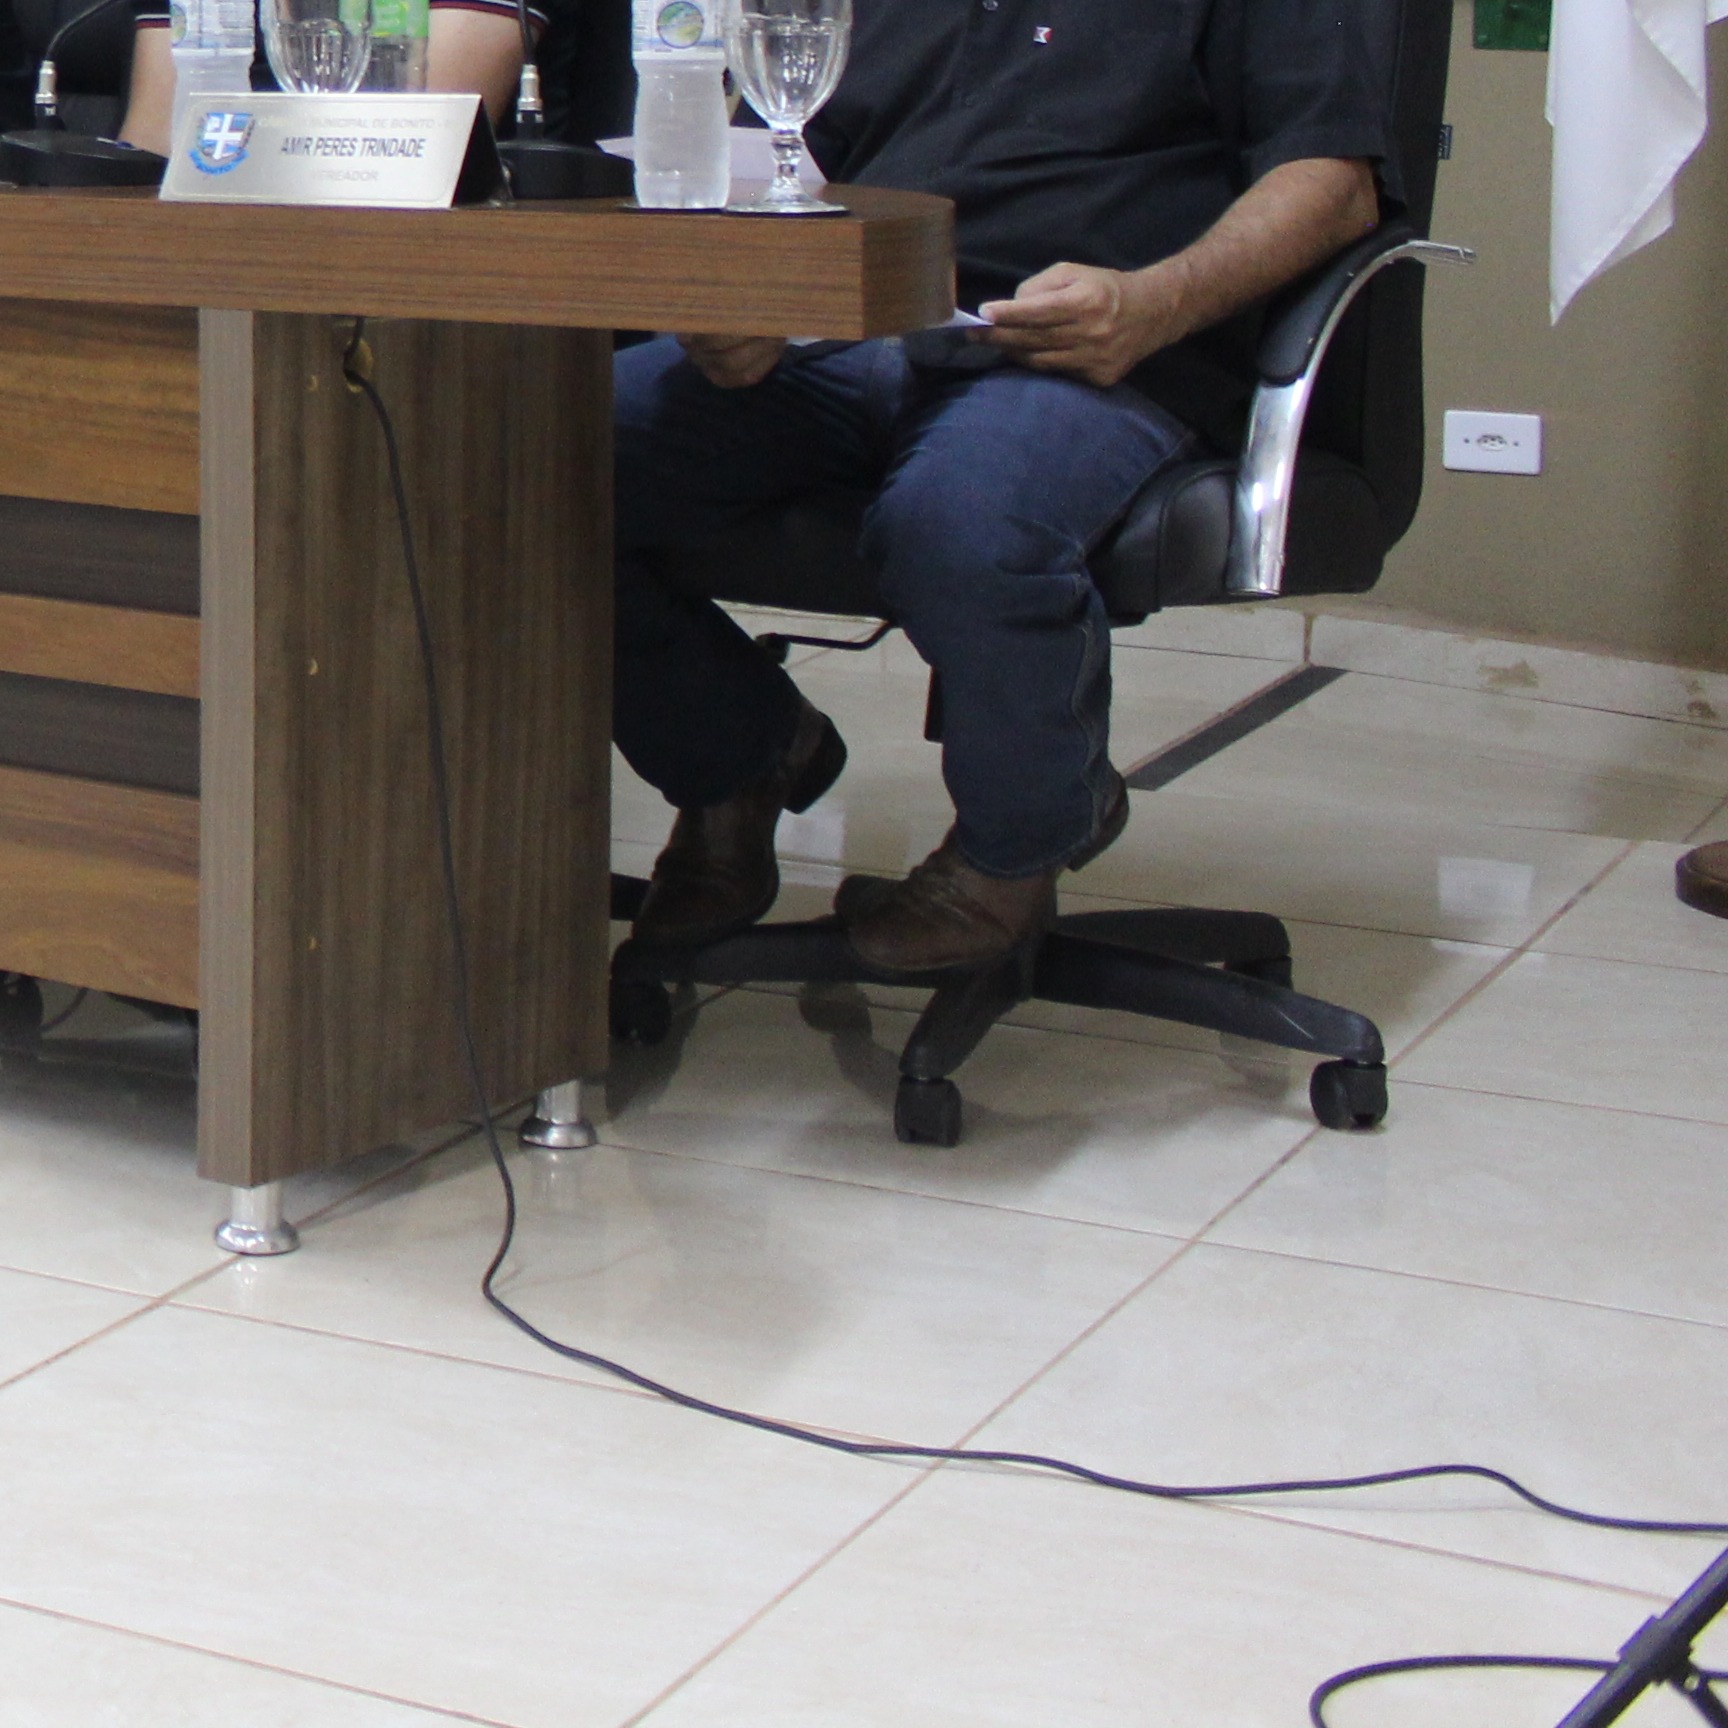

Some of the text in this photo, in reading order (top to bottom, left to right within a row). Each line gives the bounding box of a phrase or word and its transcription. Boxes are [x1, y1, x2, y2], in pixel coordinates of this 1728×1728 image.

[281, 136, 426, 159] AMIR PERES TRINDADE
